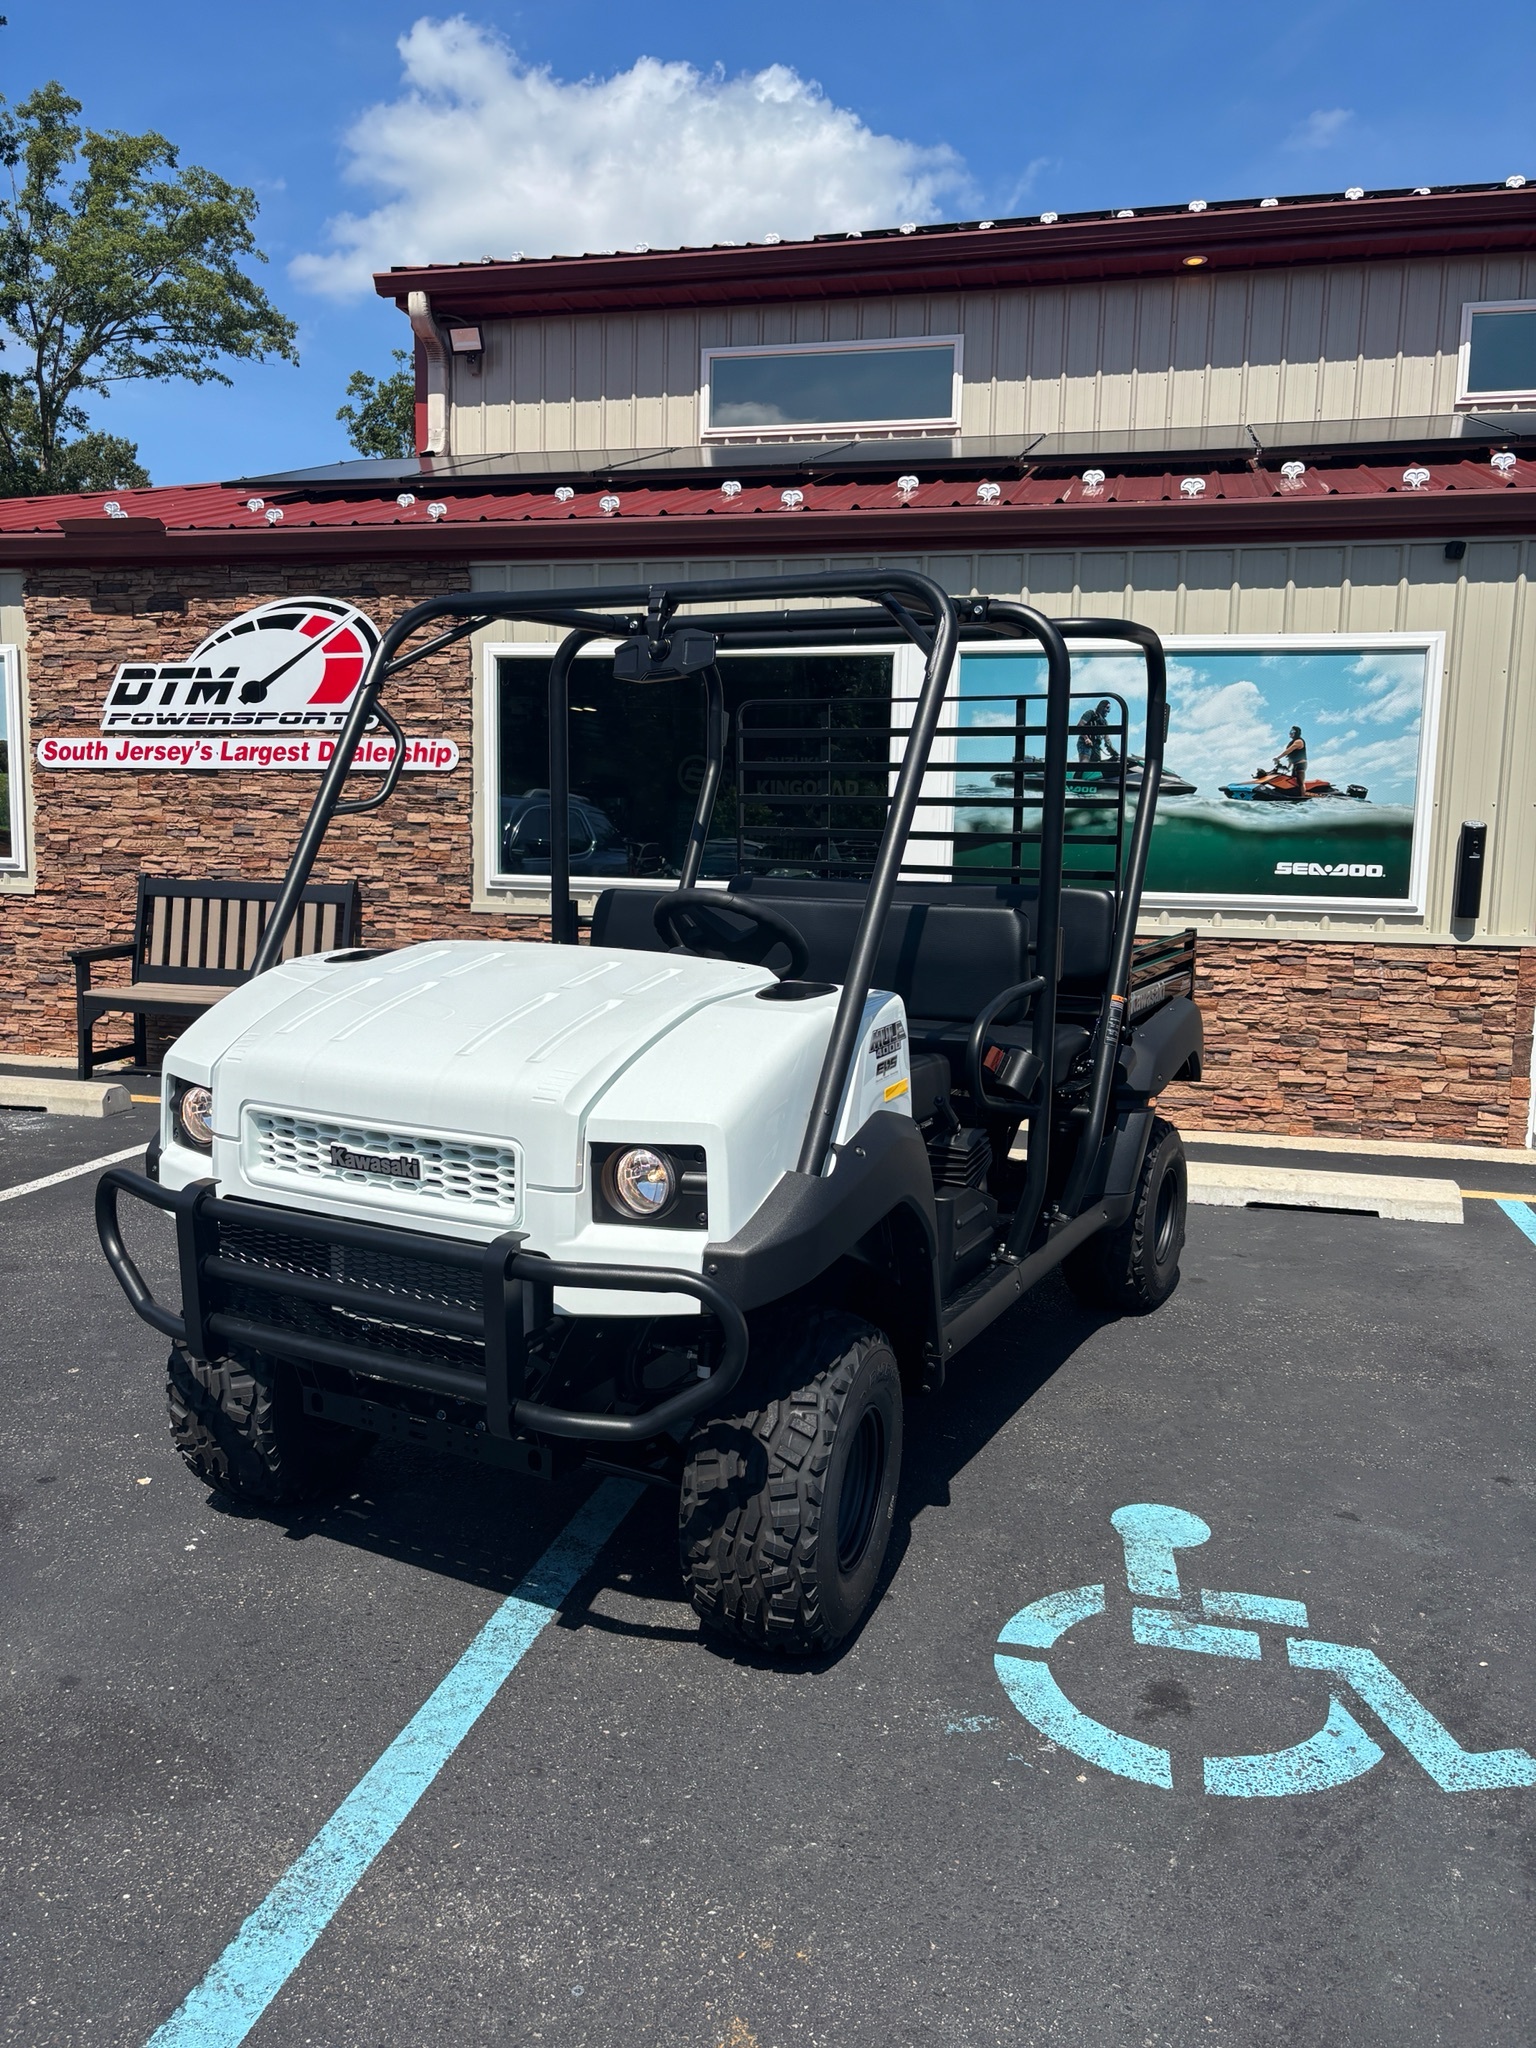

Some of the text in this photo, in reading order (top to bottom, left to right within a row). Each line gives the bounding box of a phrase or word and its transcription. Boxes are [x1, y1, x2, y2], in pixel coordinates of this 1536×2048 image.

[110, 666, 240, 706] DTM
[107, 711, 375, 725] POWERSPORT
[44, 740, 108, 761] South
[115, 740, 213, 765] Jersey's
[220, 741, 310, 766] Largest
[869, 1020, 907, 1053] MULE
[876, 1040, 902, 1060] 4000
[330, 1145, 420, 1180] Kawasaki
